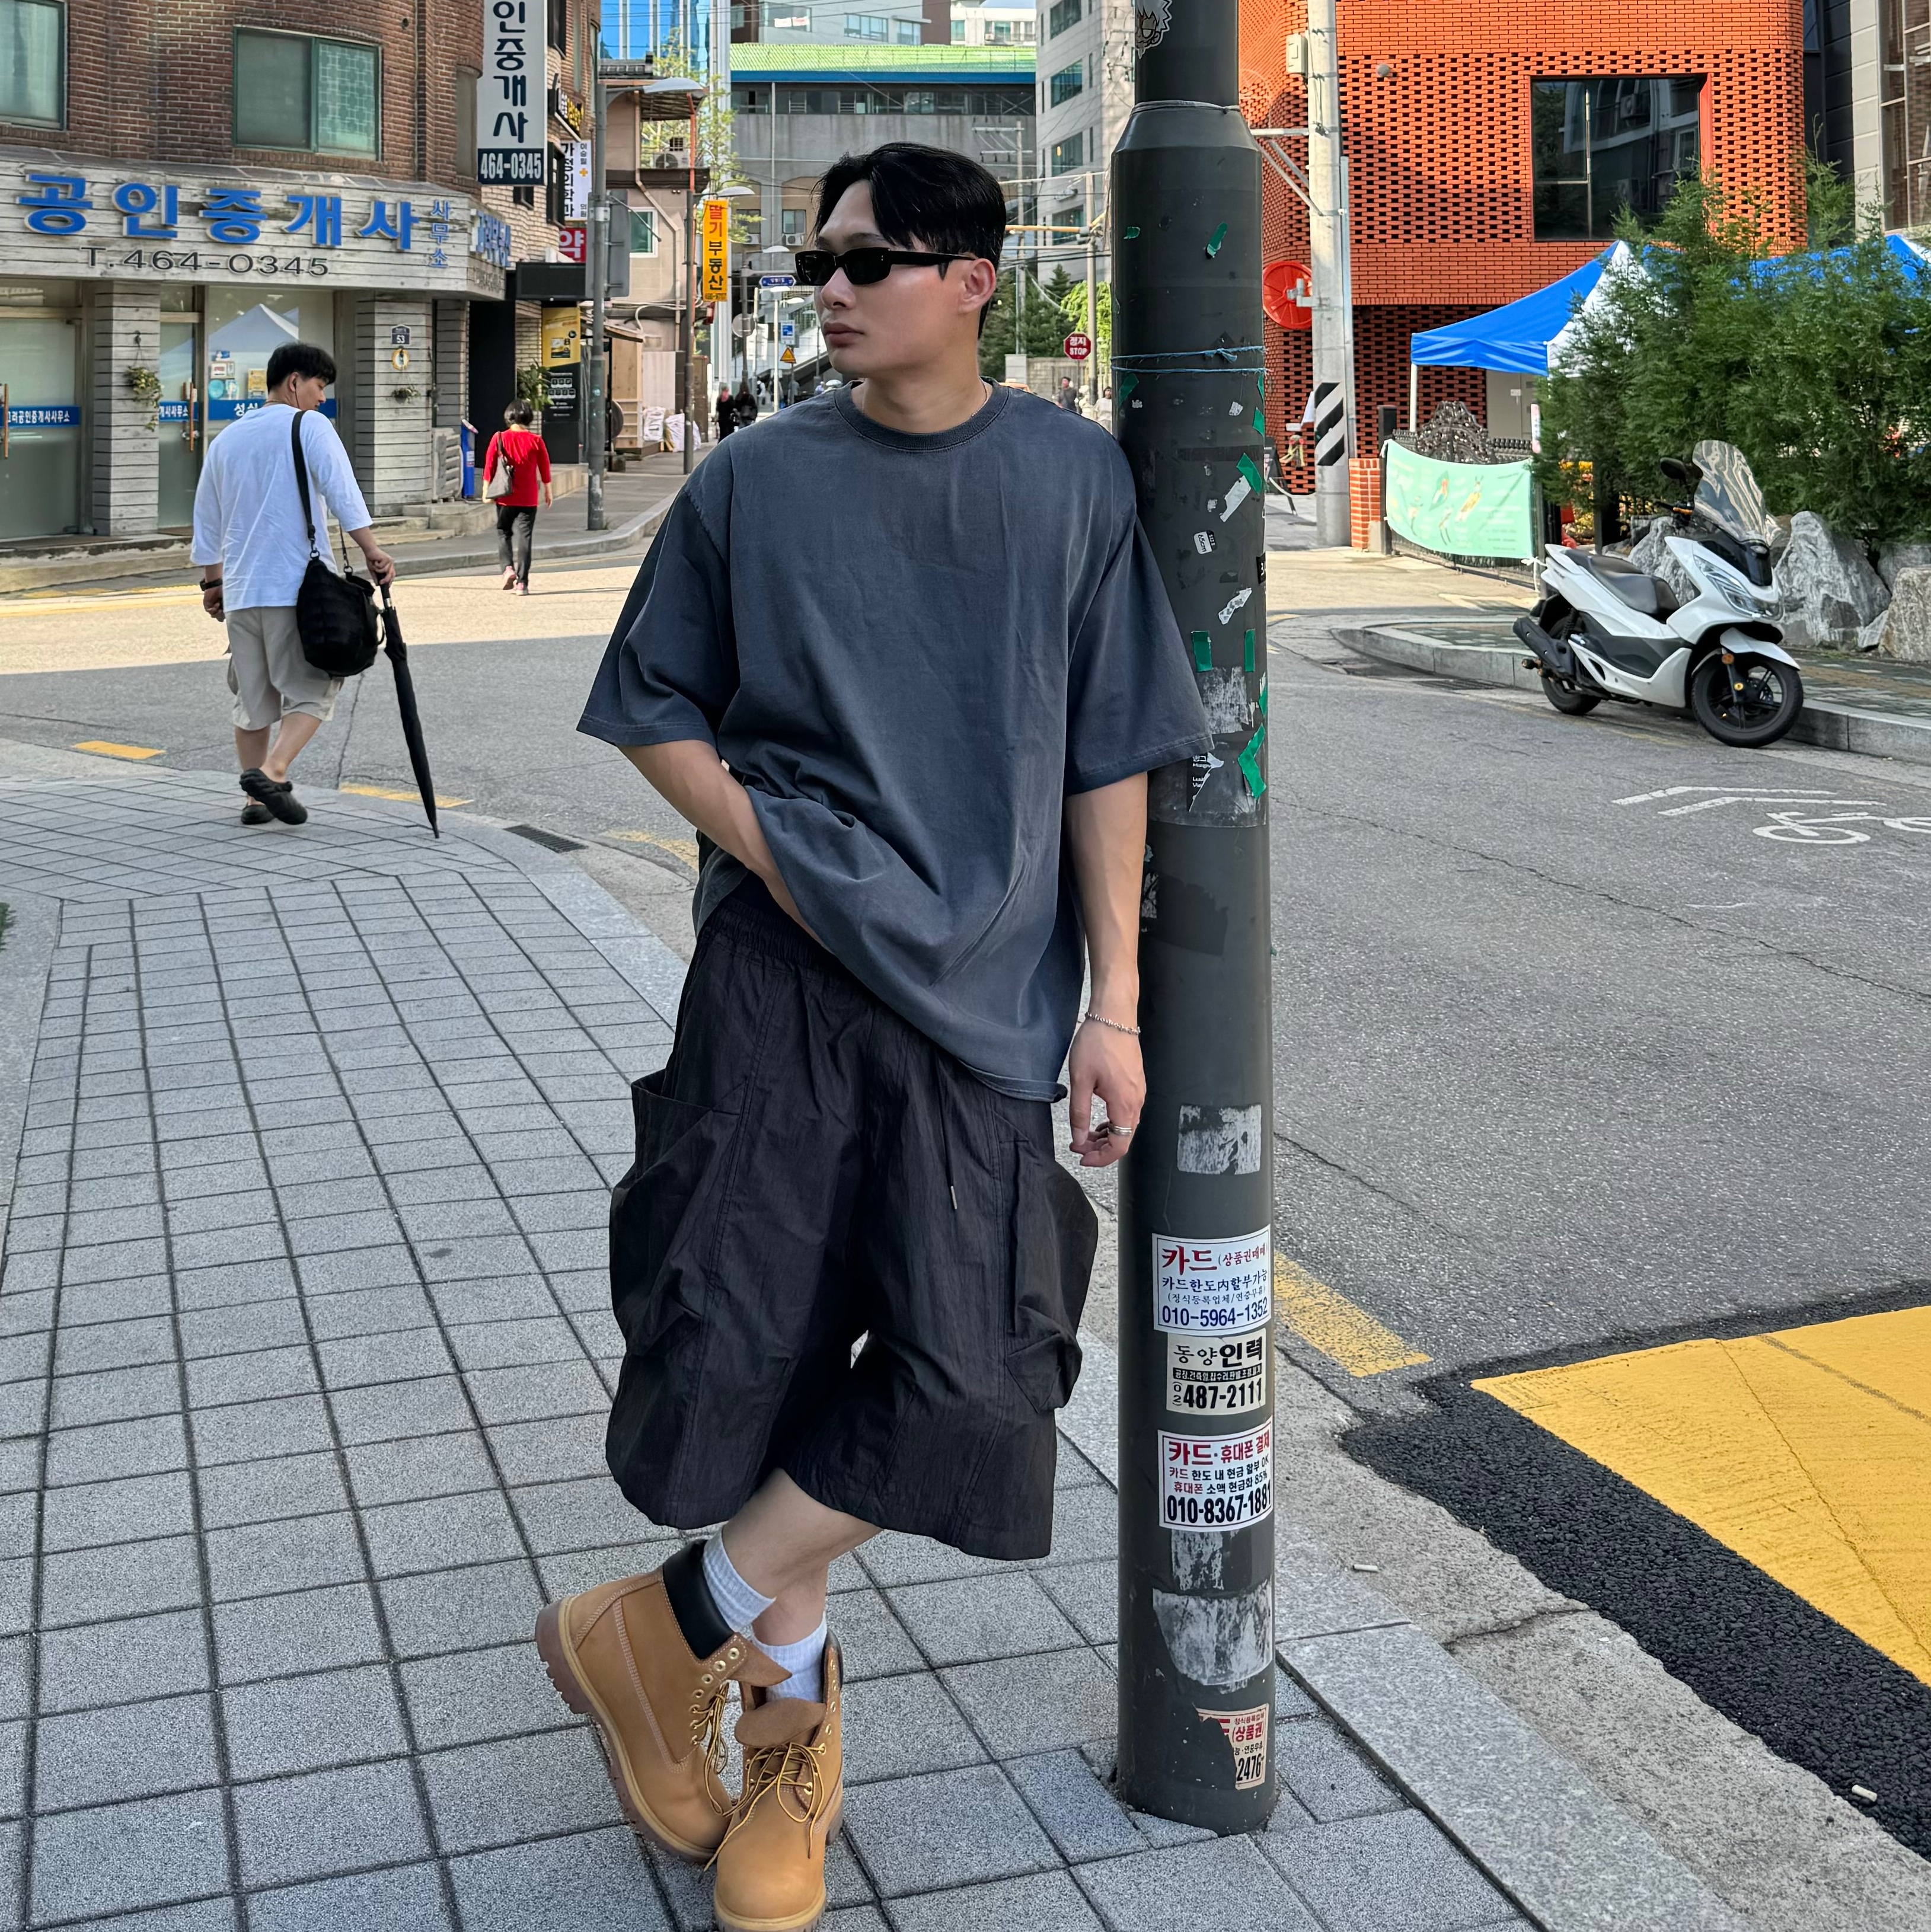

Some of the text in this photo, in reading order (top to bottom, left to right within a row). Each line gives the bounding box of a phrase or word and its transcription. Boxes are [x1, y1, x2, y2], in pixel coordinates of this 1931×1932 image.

[480, 153, 541, 179] 464-0345
[18, 173, 420, 250] 공인중개사
[429, 200, 449, 269] 사무소
[560, 231, 585, 261] 약
[708, 241, 723, 290] 부동산
[397, 335, 405, 343] 53
[1070, 337, 1086, 346] 정지
[1162, 1245, 1217, 1275] 카드
[1162, 1296, 1268, 1327] 010-5964-1352
[1183, 1378, 1262, 1409] 487-2111
[1169, 1467, 1189, 1479] 카드
[1192, 1470, 1212, 1481] 한도
[1215, 1470, 1224, 1480] 내
[1227, 1467, 1244, 1479] 현금
[1261, 1455, 1269, 1467] OK
[1174, 1470, 1268, 1494] 휴대폰 소액 현금화 85%
[1167, 1479, 1271, 1524] 010-8367-1881
[1237, 1753, 1262, 1781] 2476
